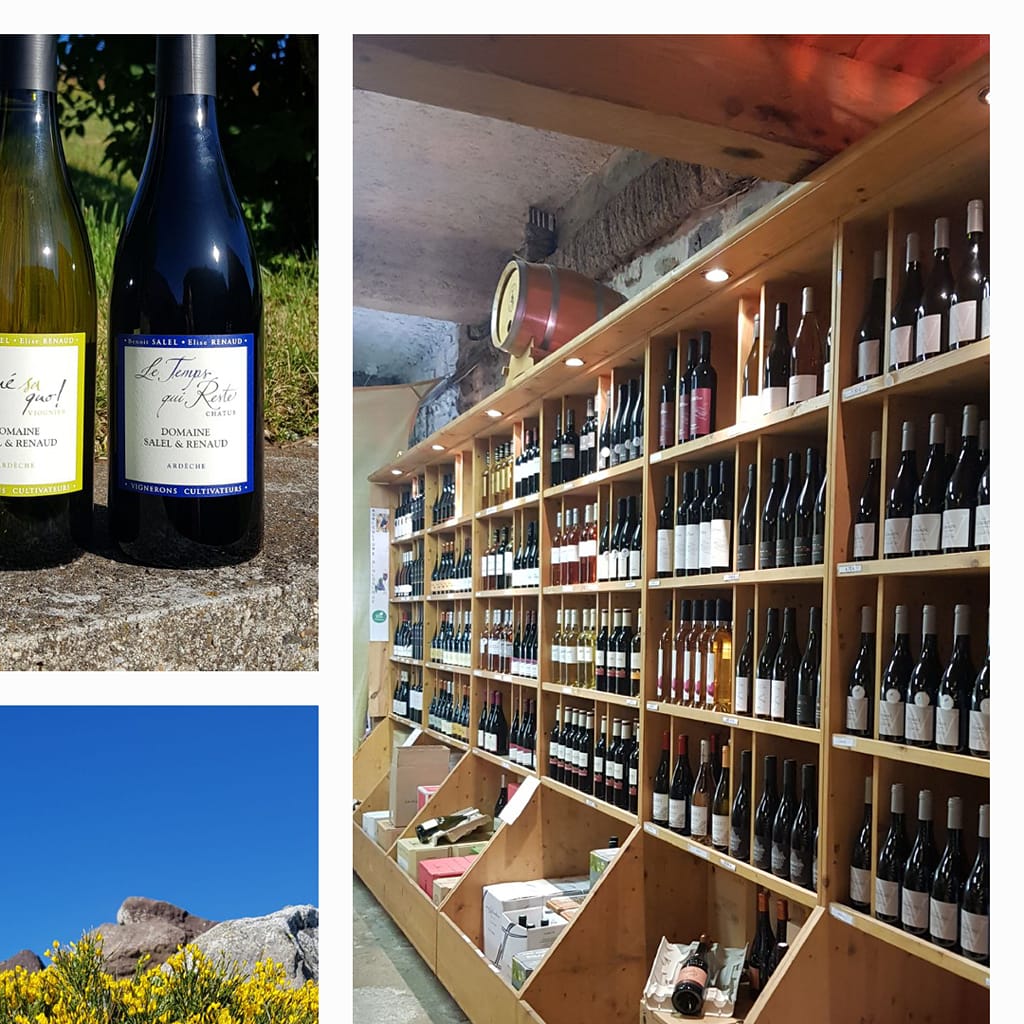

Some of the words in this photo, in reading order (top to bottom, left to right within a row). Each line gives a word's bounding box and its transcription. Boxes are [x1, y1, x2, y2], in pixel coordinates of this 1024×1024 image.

[42, 337, 73, 345] RENAUD
[151, 338, 178, 346] SALEL
[135, 357, 163, 381] Le
[158, 356, 212, 391] Temps
[156, 392, 186, 418] qui
[184, 377, 237, 410] Reste
[161, 428, 211, 437] DOMAINE
[4, 439, 14, 447] &
[16, 438, 58, 448] RENAUD
[144, 438, 172, 448] SALEL
[174, 440, 184, 448] &
[186, 439, 228, 448] RENAUD
[130, 482, 178, 494] VIGNERONS
[183, 485, 242, 495] CULTIVATEURS
